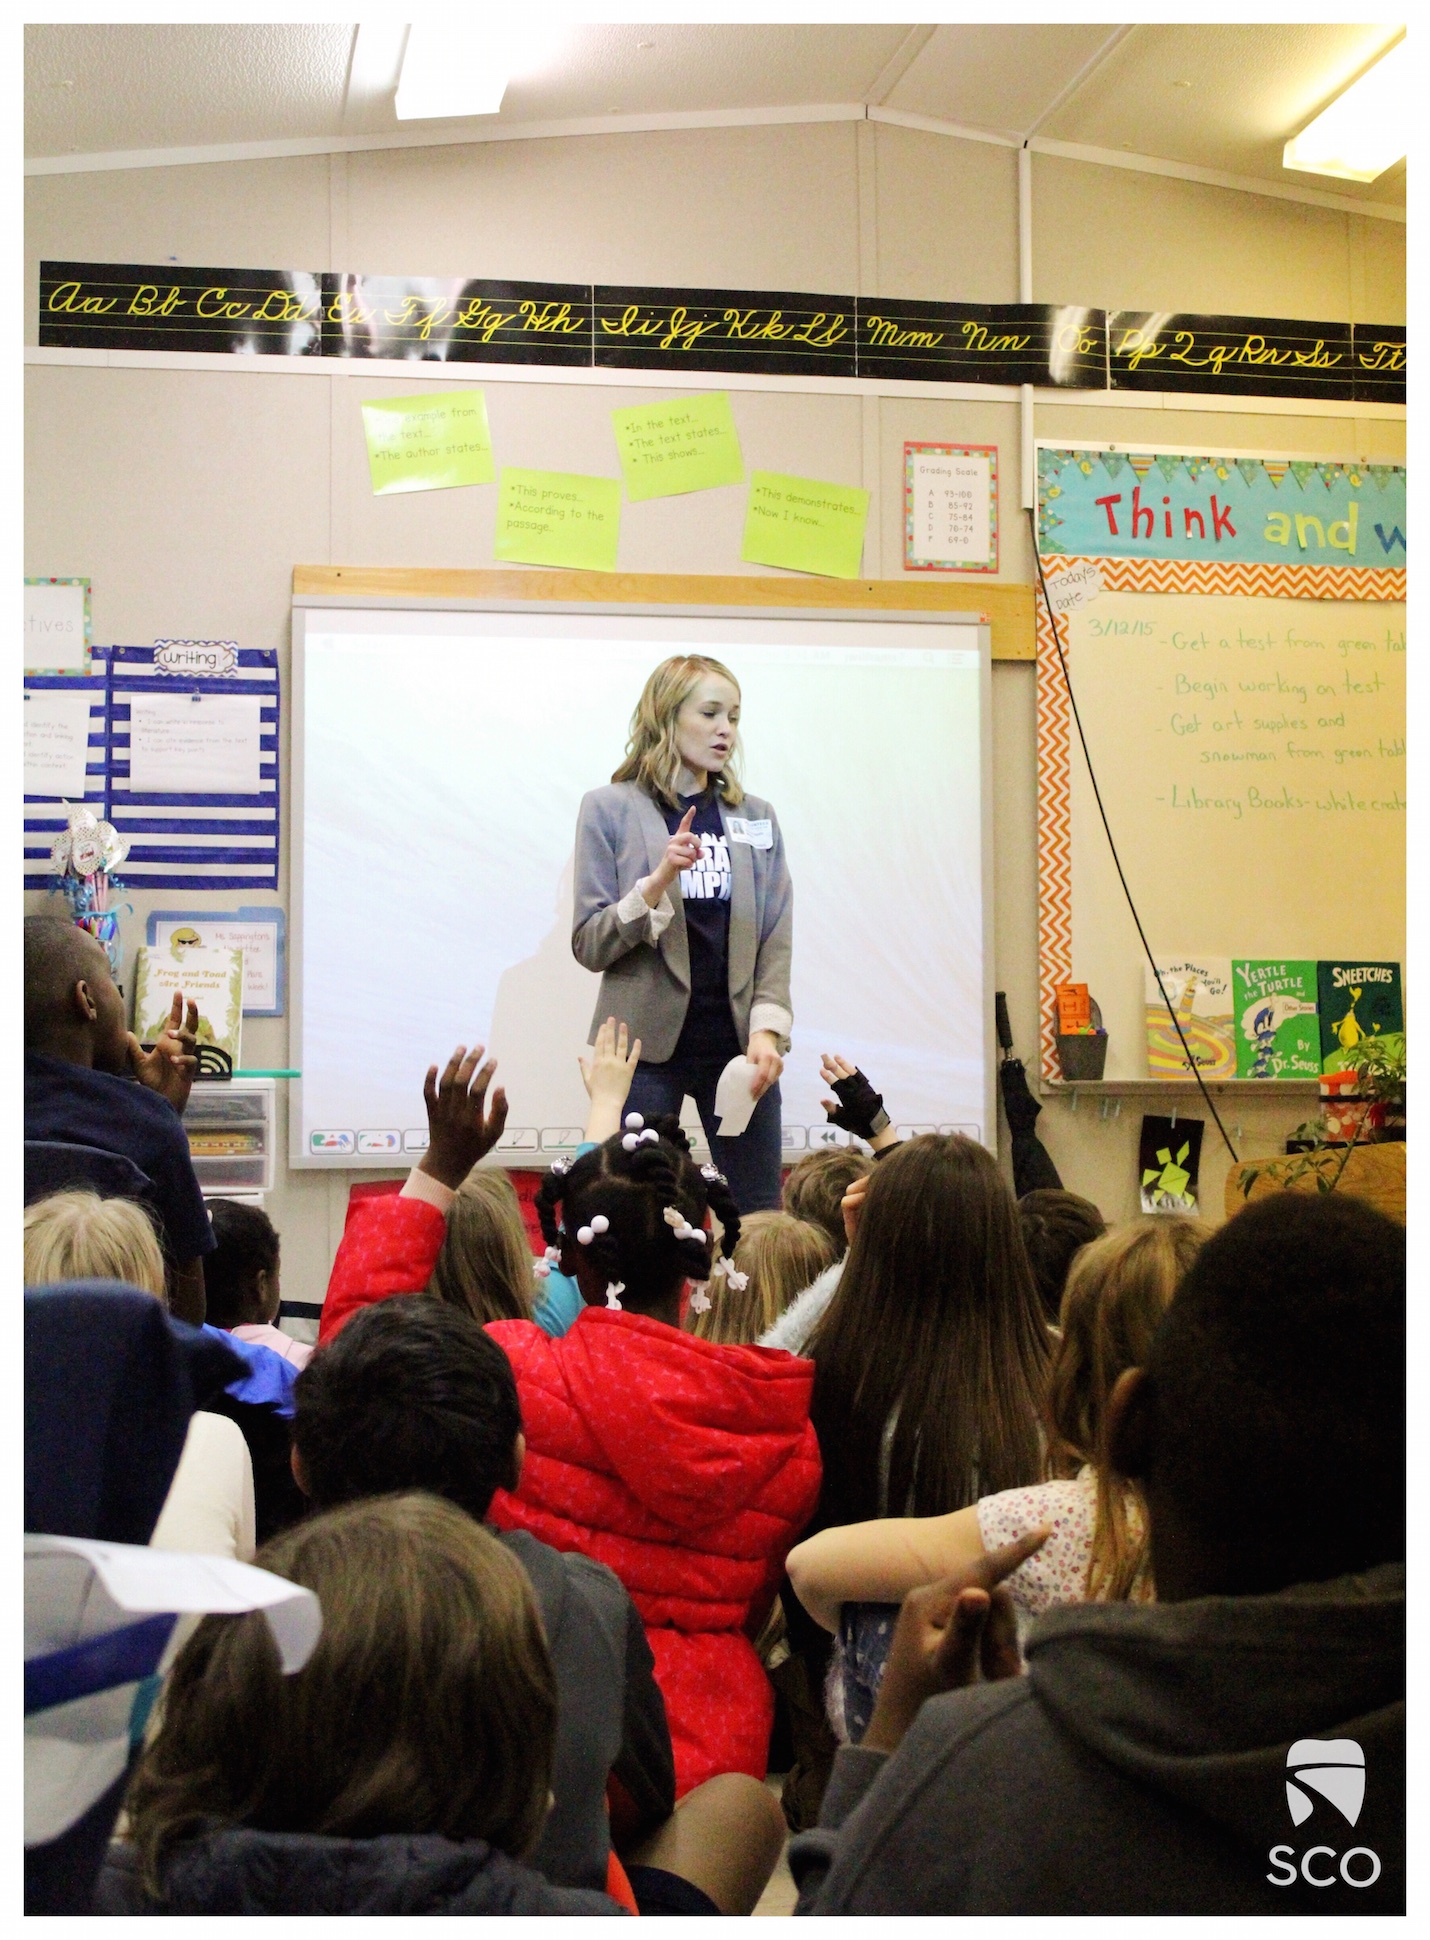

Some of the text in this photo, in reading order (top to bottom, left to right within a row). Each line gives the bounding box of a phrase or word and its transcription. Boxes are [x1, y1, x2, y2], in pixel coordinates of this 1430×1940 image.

[48, 282, 118, 313] Aa
[127, 285, 187, 316] Bb
[197, 287, 251, 319] Cc
[252, 289, 318, 321] Dd
[452, 298, 516, 342] Gg
[519, 301, 585, 333] Hh
[601, 305, 664, 336] Ii
[660, 306, 720, 350] Jj
[723, 309, 795, 339] Kk
[793, 313, 849, 347] Ll
[867, 316, 944, 349] Mm
[962, 321, 1031, 351] Nn
[1056, 324, 1098, 354] Oo
[1114, 329, 1167, 370] Pp
[1238, 335, 1293, 365] Rr
[1290, 339, 1343, 369] Ss
[405, 409, 446, 423] example
[452, 407, 477, 418] from
[630, 422, 642, 433] In
[647, 420, 664, 431] the
[634, 437, 654, 449] The
[659, 433, 681, 445] text
[380, 450, 400, 460] The
[406, 447, 439, 459] author
[642, 452, 663, 464] This
[920, 466, 978, 477] Grading Scale
[517, 484, 537, 497] This
[761, 486, 781, 500] This
[928, 489, 972, 499] A 93-100
[514, 501, 604, 521] According to the
[758, 505, 779, 518] Now
[783, 509, 789, 521] I
[928, 501, 973, 511] B 85-92
[928, 512, 973, 521] C 75-84
[1095, 486, 1237, 543] Think
[1264, 501, 1359, 556] and
[949, 525, 974, 533] 70-74
[928, 535, 969, 545] F 69-0
[1055, 592, 1083, 610] Date
[24, 614, 74, 633] tives
[1088, 618, 1157, 637] 3/12/15
[1172, 631, 1210, 651] Get
[1219, 638, 1231, 649] a
[1236, 627, 1278, 651] test
[1284, 628, 1325, 649] from
[1338, 640, 1377, 658] green
[163, 650, 217, 669] writing
[1176, 668, 1386, 704] Begin working on test
[1170, 709, 1346, 736] Get art supplies and
[1200, 751, 1277, 763] snowman
[1286, 741, 1324, 759] from
[1335, 749, 1372, 764] green
[1172, 784, 1242, 820] Library
[1316, 789, 1368, 811] white
[153, 968, 227, 979] Frog and Toad
[1170, 965, 1183, 973] the
[1184, 963, 1209, 977] Places
[1236, 962, 1287, 988] YERTLE
[1332, 966, 1394, 987] SNEETCHES
[182, 980, 221, 989] Friends
[1209, 984, 1228, 996] Go!
[1244, 977, 1303, 1001] the TURTLE
[1297, 1039, 1311, 1052] By
[1271, 1057, 1290, 1074] Dr.
[1291, 1054, 1319, 1074] Seuss
